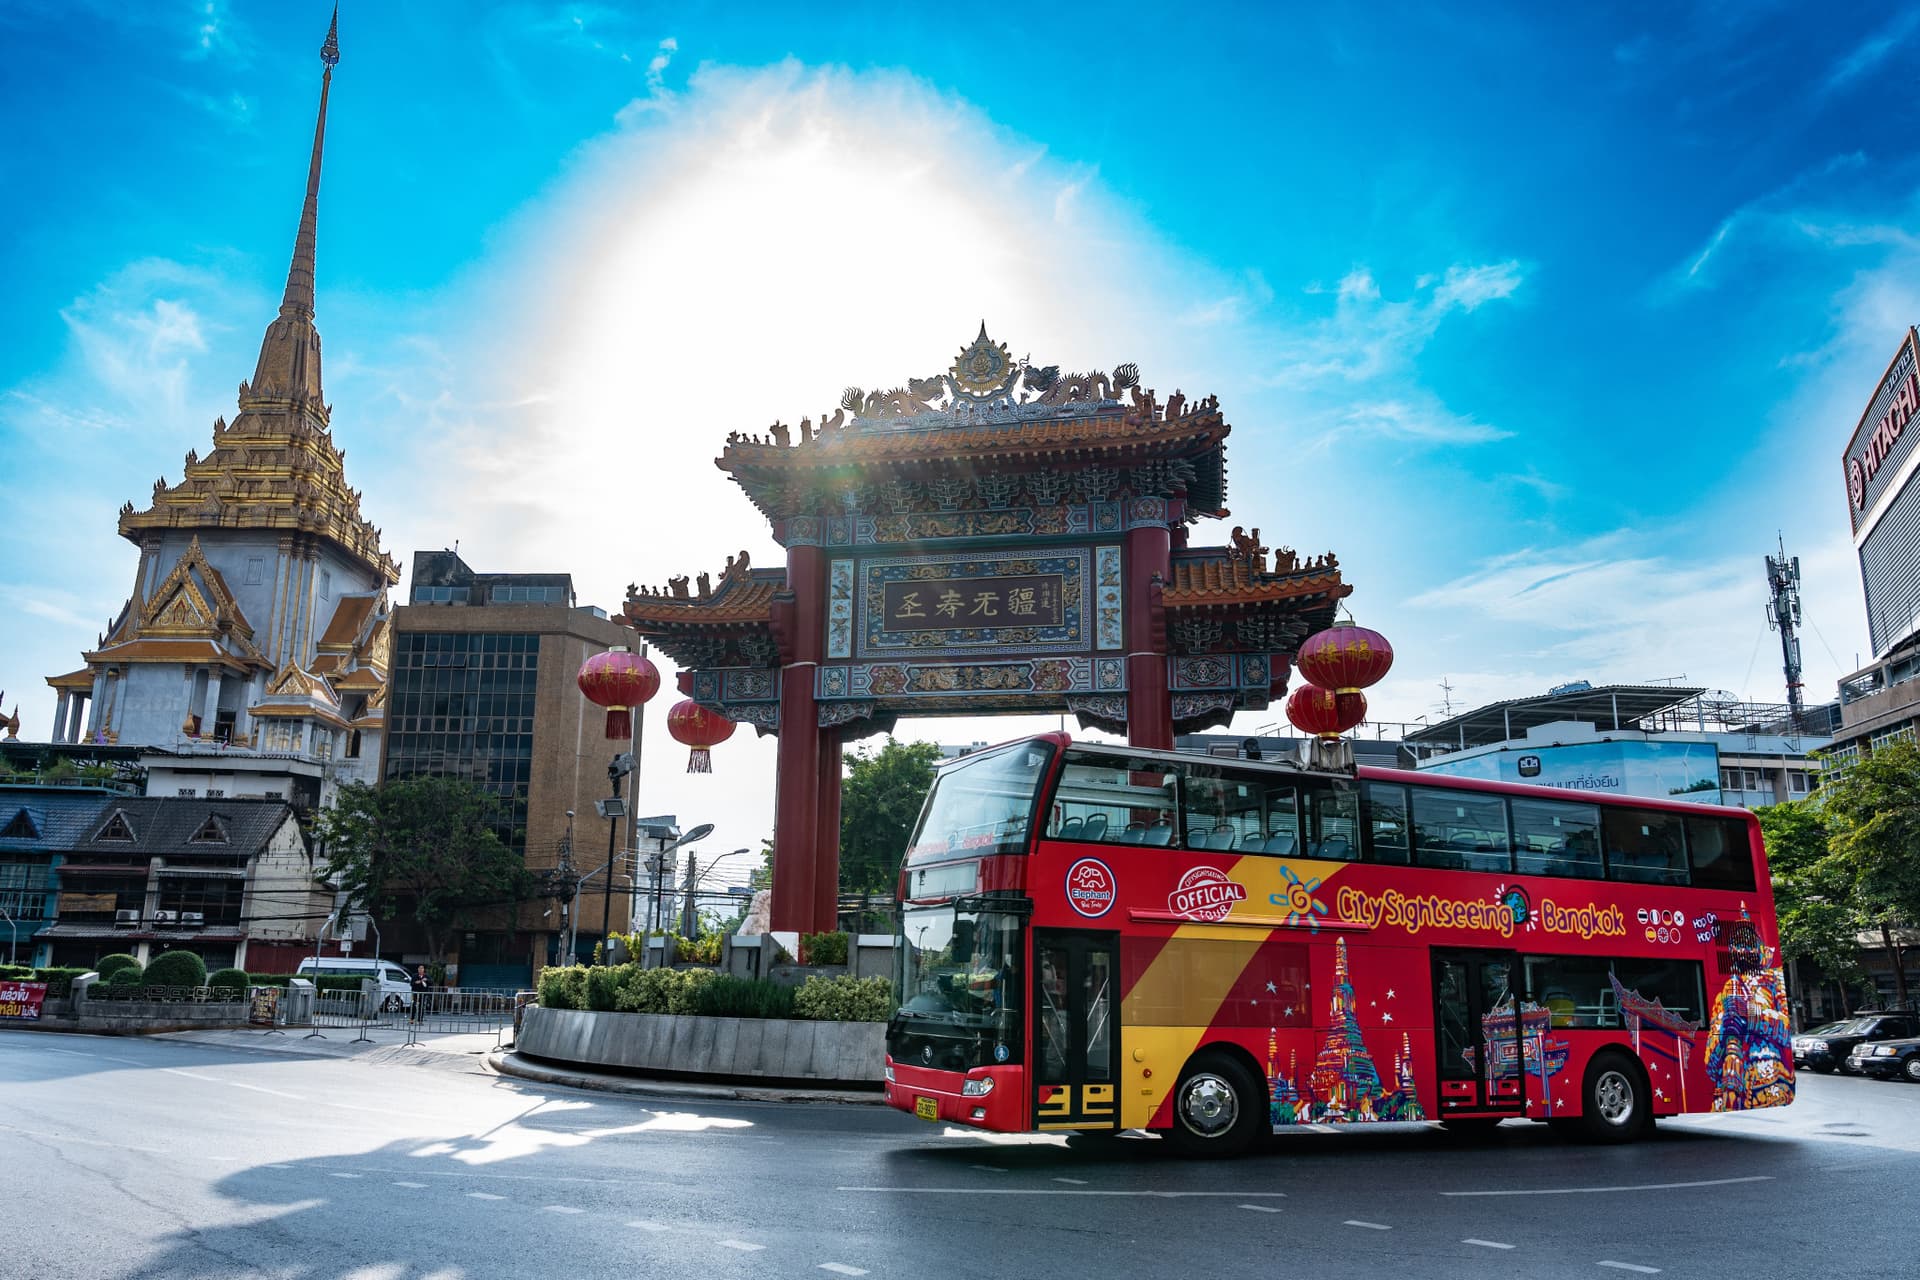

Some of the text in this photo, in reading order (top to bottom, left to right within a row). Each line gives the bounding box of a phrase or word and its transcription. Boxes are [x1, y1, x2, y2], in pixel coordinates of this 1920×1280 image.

[1863, 374, 1919, 481] HITACHI
[894, 587, 1038, 619] 圣寿无疆
[1071, 888, 1110, 901] Elephant
[1176, 885, 1243, 911] OFFICIAL
[1199, 904, 1228, 920] TOUR
[1542, 898, 1626, 940] Bangkok
[1692, 917, 1707, 929] Hop
[1696, 931, 1711, 943] Hop
